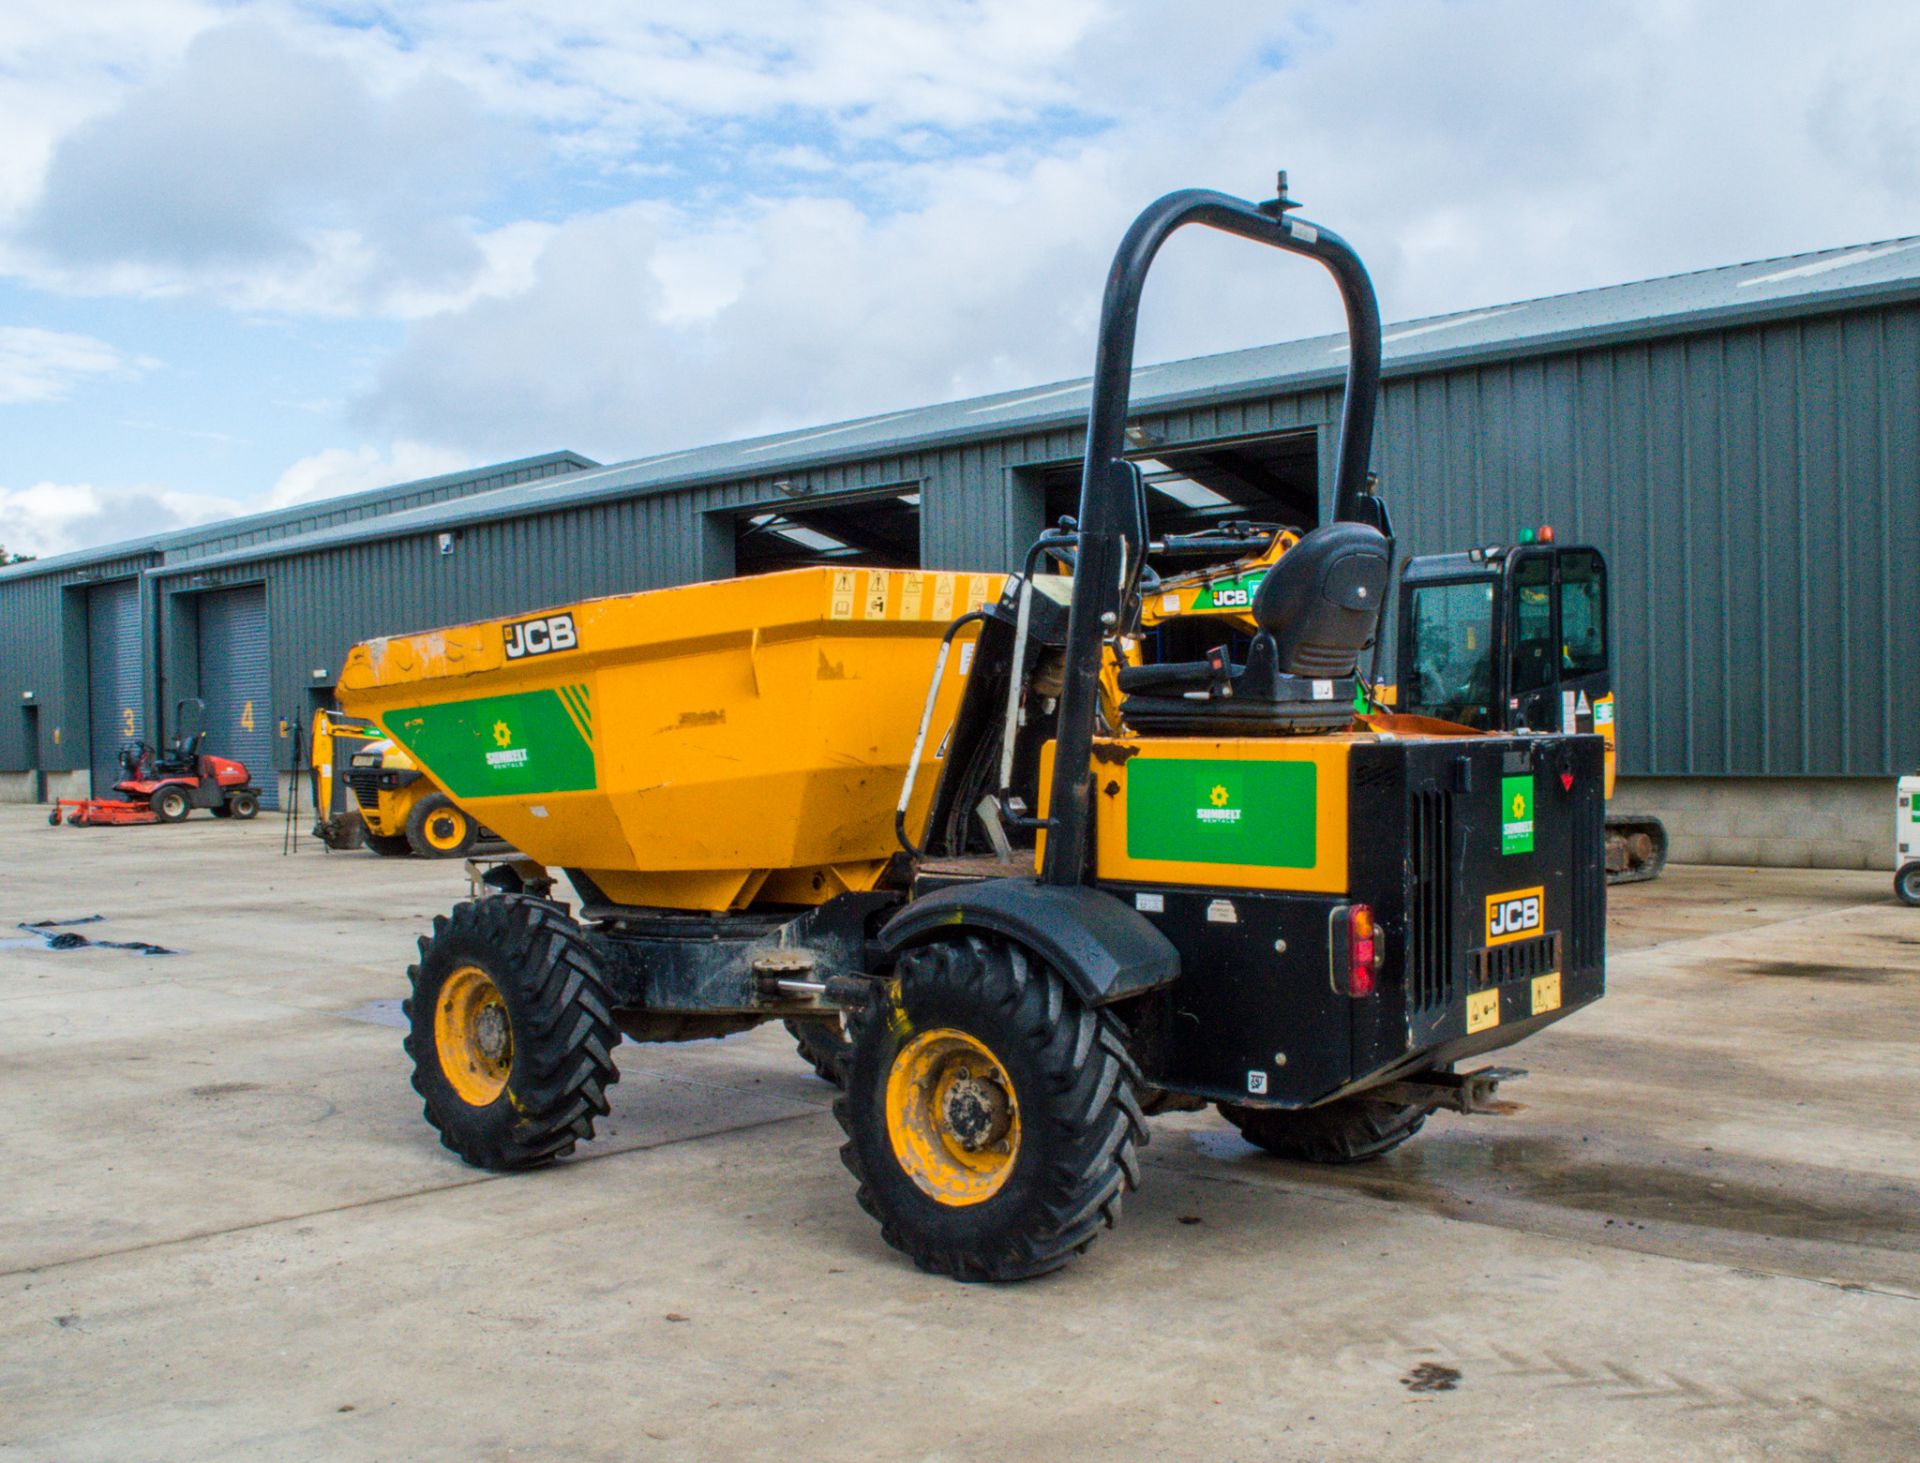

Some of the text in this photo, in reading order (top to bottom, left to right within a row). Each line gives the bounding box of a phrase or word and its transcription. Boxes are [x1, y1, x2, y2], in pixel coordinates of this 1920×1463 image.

[1213, 590, 1247, 606] JCB
[504, 616, 576, 657] JCB
[123, 708, 134, 736] 3
[241, 701, 254, 732] 4
[485, 748, 527, 765] SUNBELT
[1196, 808, 1241, 819] SUNBELT
[1490, 897, 1540, 935] JCB
